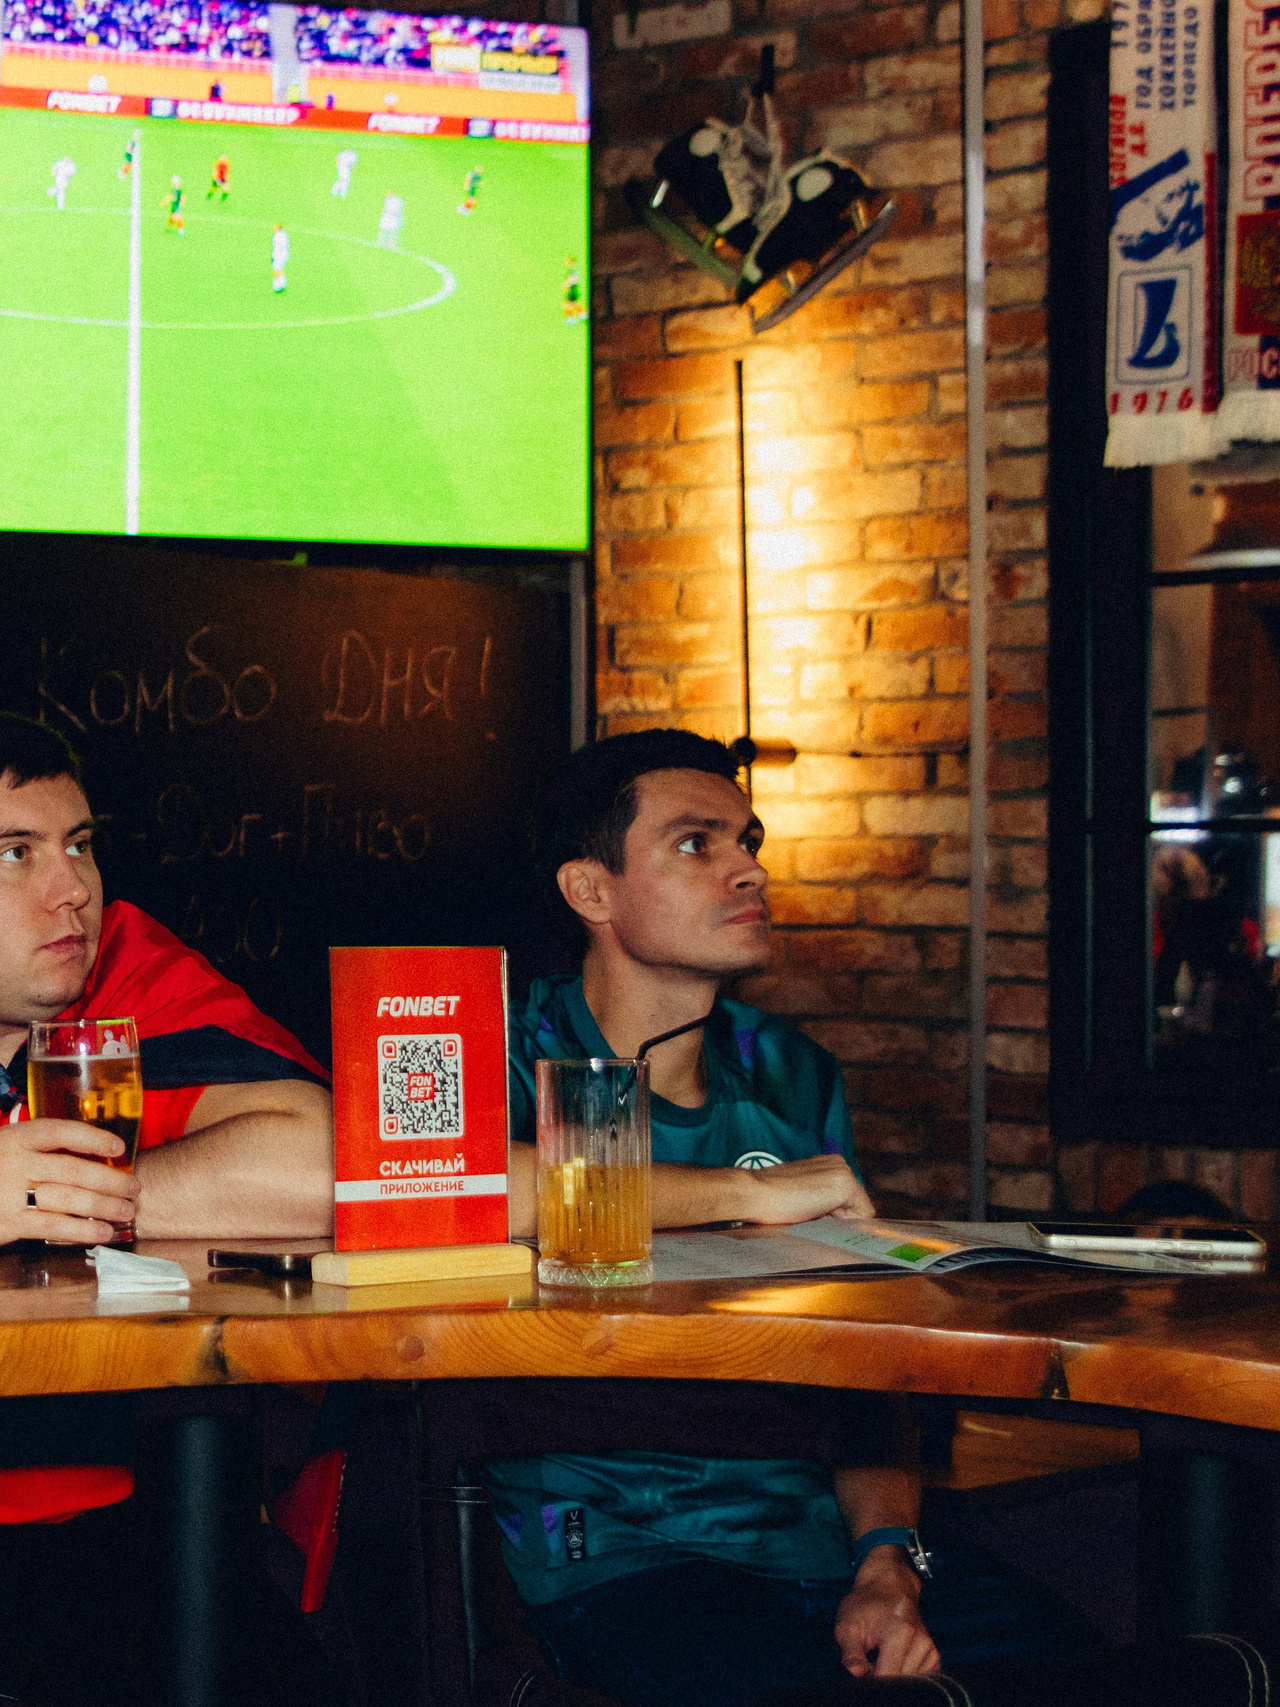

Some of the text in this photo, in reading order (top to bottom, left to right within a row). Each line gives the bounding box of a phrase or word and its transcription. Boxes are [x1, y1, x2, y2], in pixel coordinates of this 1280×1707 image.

[1110, 386, 1193, 415] 1976
[38, 624, 276, 733] Комбо
[377, 996, 460, 1017] FONBET
[410, 1075, 432, 1087] FON
[410, 1086, 432, 1098] BET
[379, 1152, 465, 1176] СКАЧИВАЙ
[380, 1180, 464, 1195] ПРИЛОЖЕНИЕ
